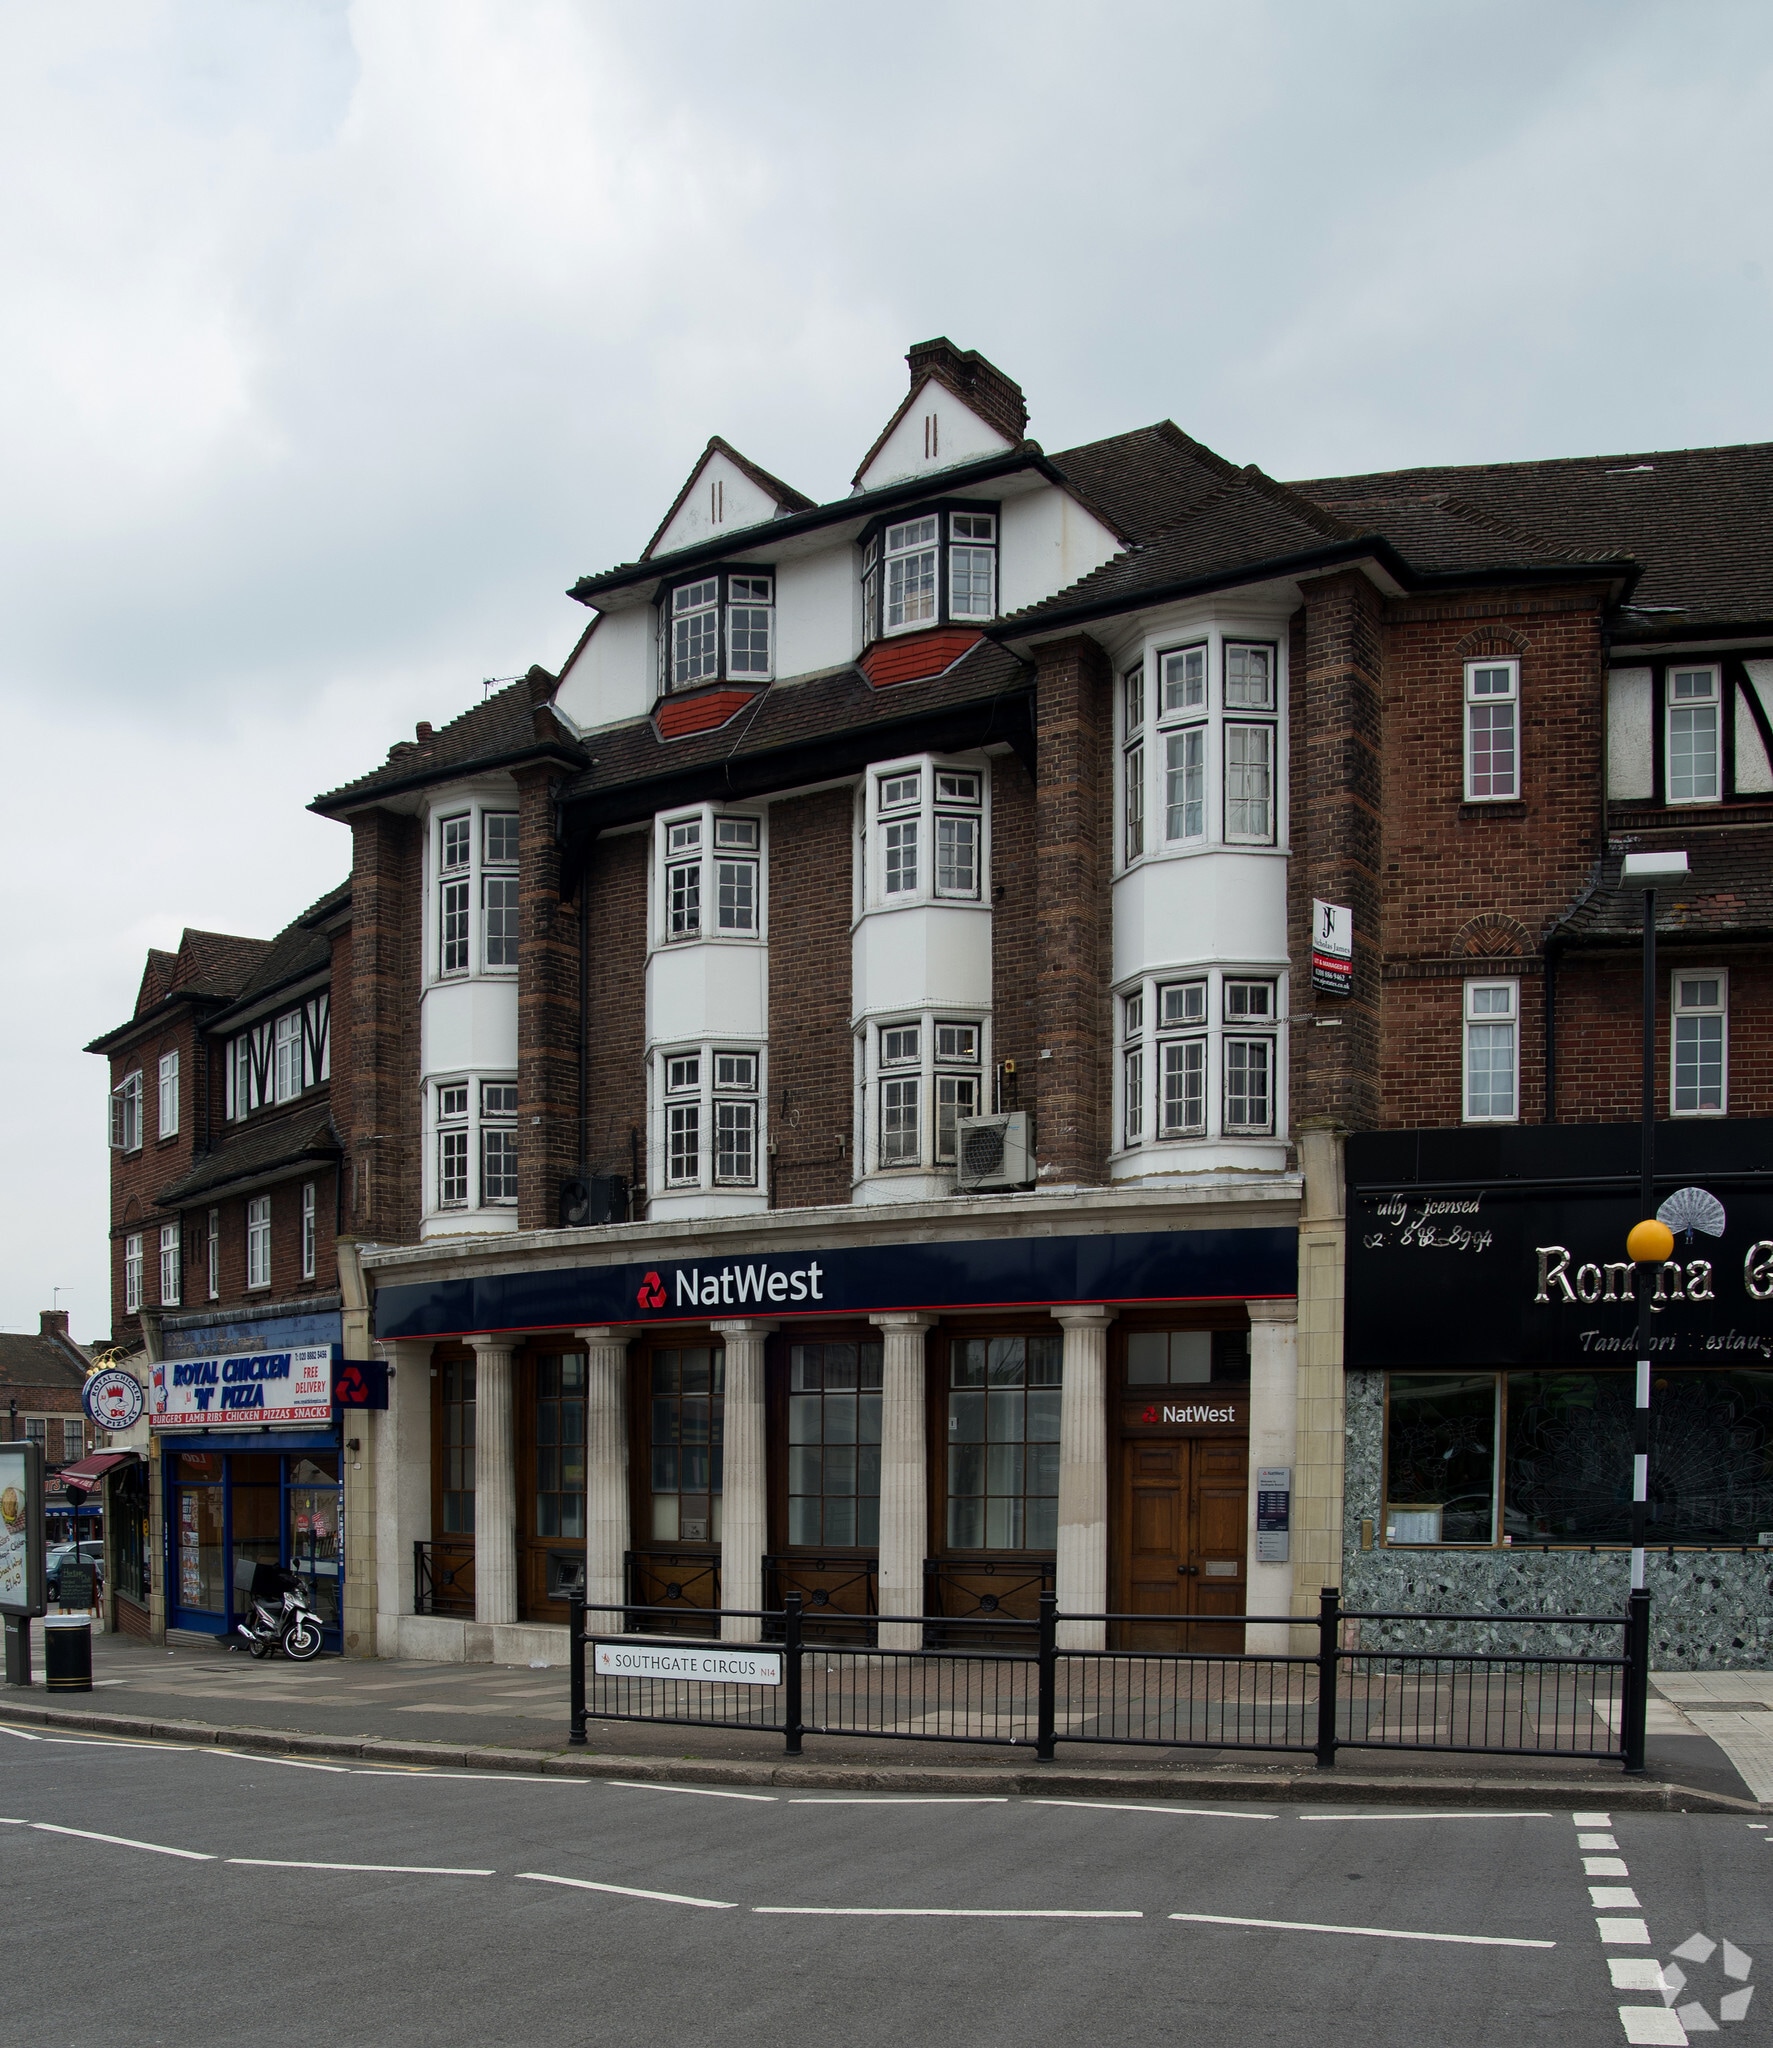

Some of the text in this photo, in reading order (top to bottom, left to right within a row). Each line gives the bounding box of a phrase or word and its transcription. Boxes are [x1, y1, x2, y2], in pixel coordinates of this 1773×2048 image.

[1333, 943, 1350, 954] James
[676, 1261, 824, 1307] NatWest
[1579, 1326, 1676, 1351] Tandori
[173, 1353, 291, 1387] ROYAL CHICKEN
[303, 1366, 318, 1379] FREE
[92, 1374, 141, 1401] ROYAL CHICKEN
[220, 1384, 264, 1409] PIZZA
[295, 1381, 326, 1394] DELIVERY
[106, 1410, 137, 1427] PIZZAS
[152, 1407, 326, 1424] BURGERS LAMB RIBS CHICKEN PIZZAS SNACKS
[1163, 1405, 1236, 1423] NatWest
[615, 1654, 776, 1678] SOUTHGATE CIRCUS N14
